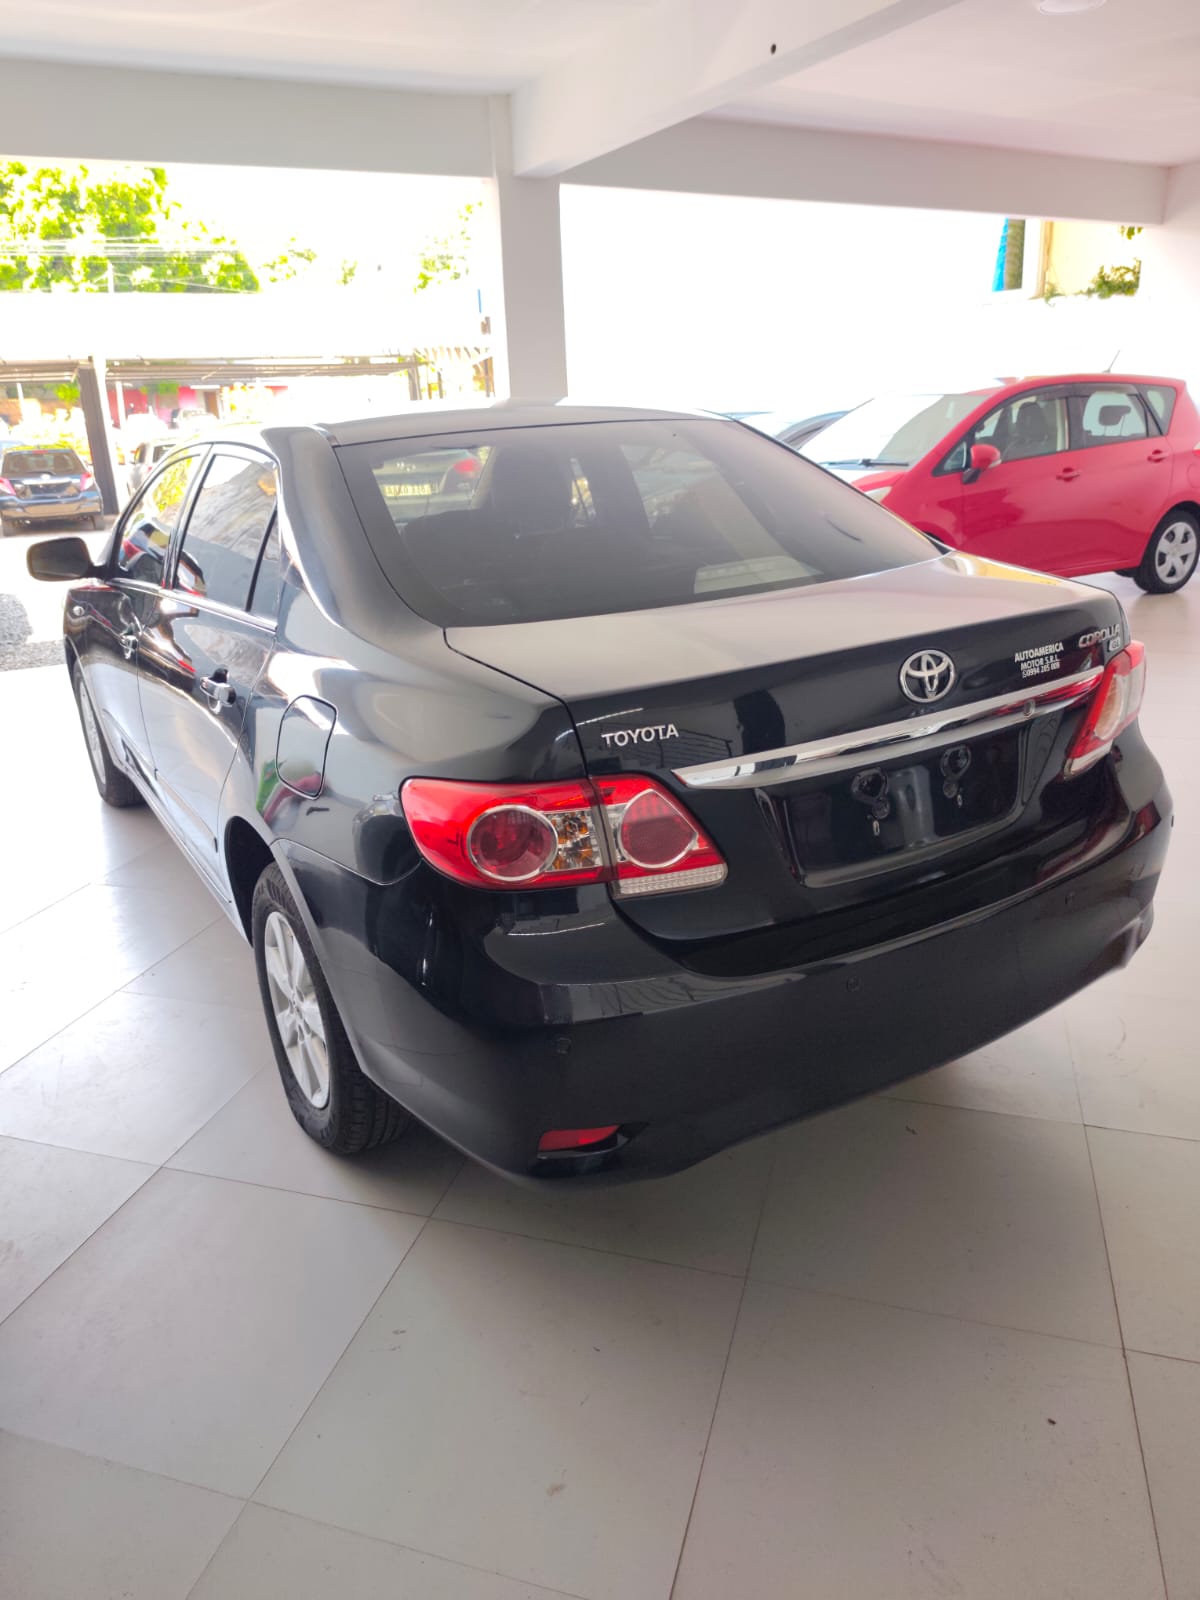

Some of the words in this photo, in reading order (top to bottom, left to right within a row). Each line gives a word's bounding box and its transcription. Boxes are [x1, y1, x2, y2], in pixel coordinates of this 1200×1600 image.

[1078, 624, 1119, 648] COROLLA
[1014, 642, 1064, 662] AUTOAMERICA
[1020, 657, 1044, 670] MOTOR
[601, 724, 679, 747] TOYOTA
